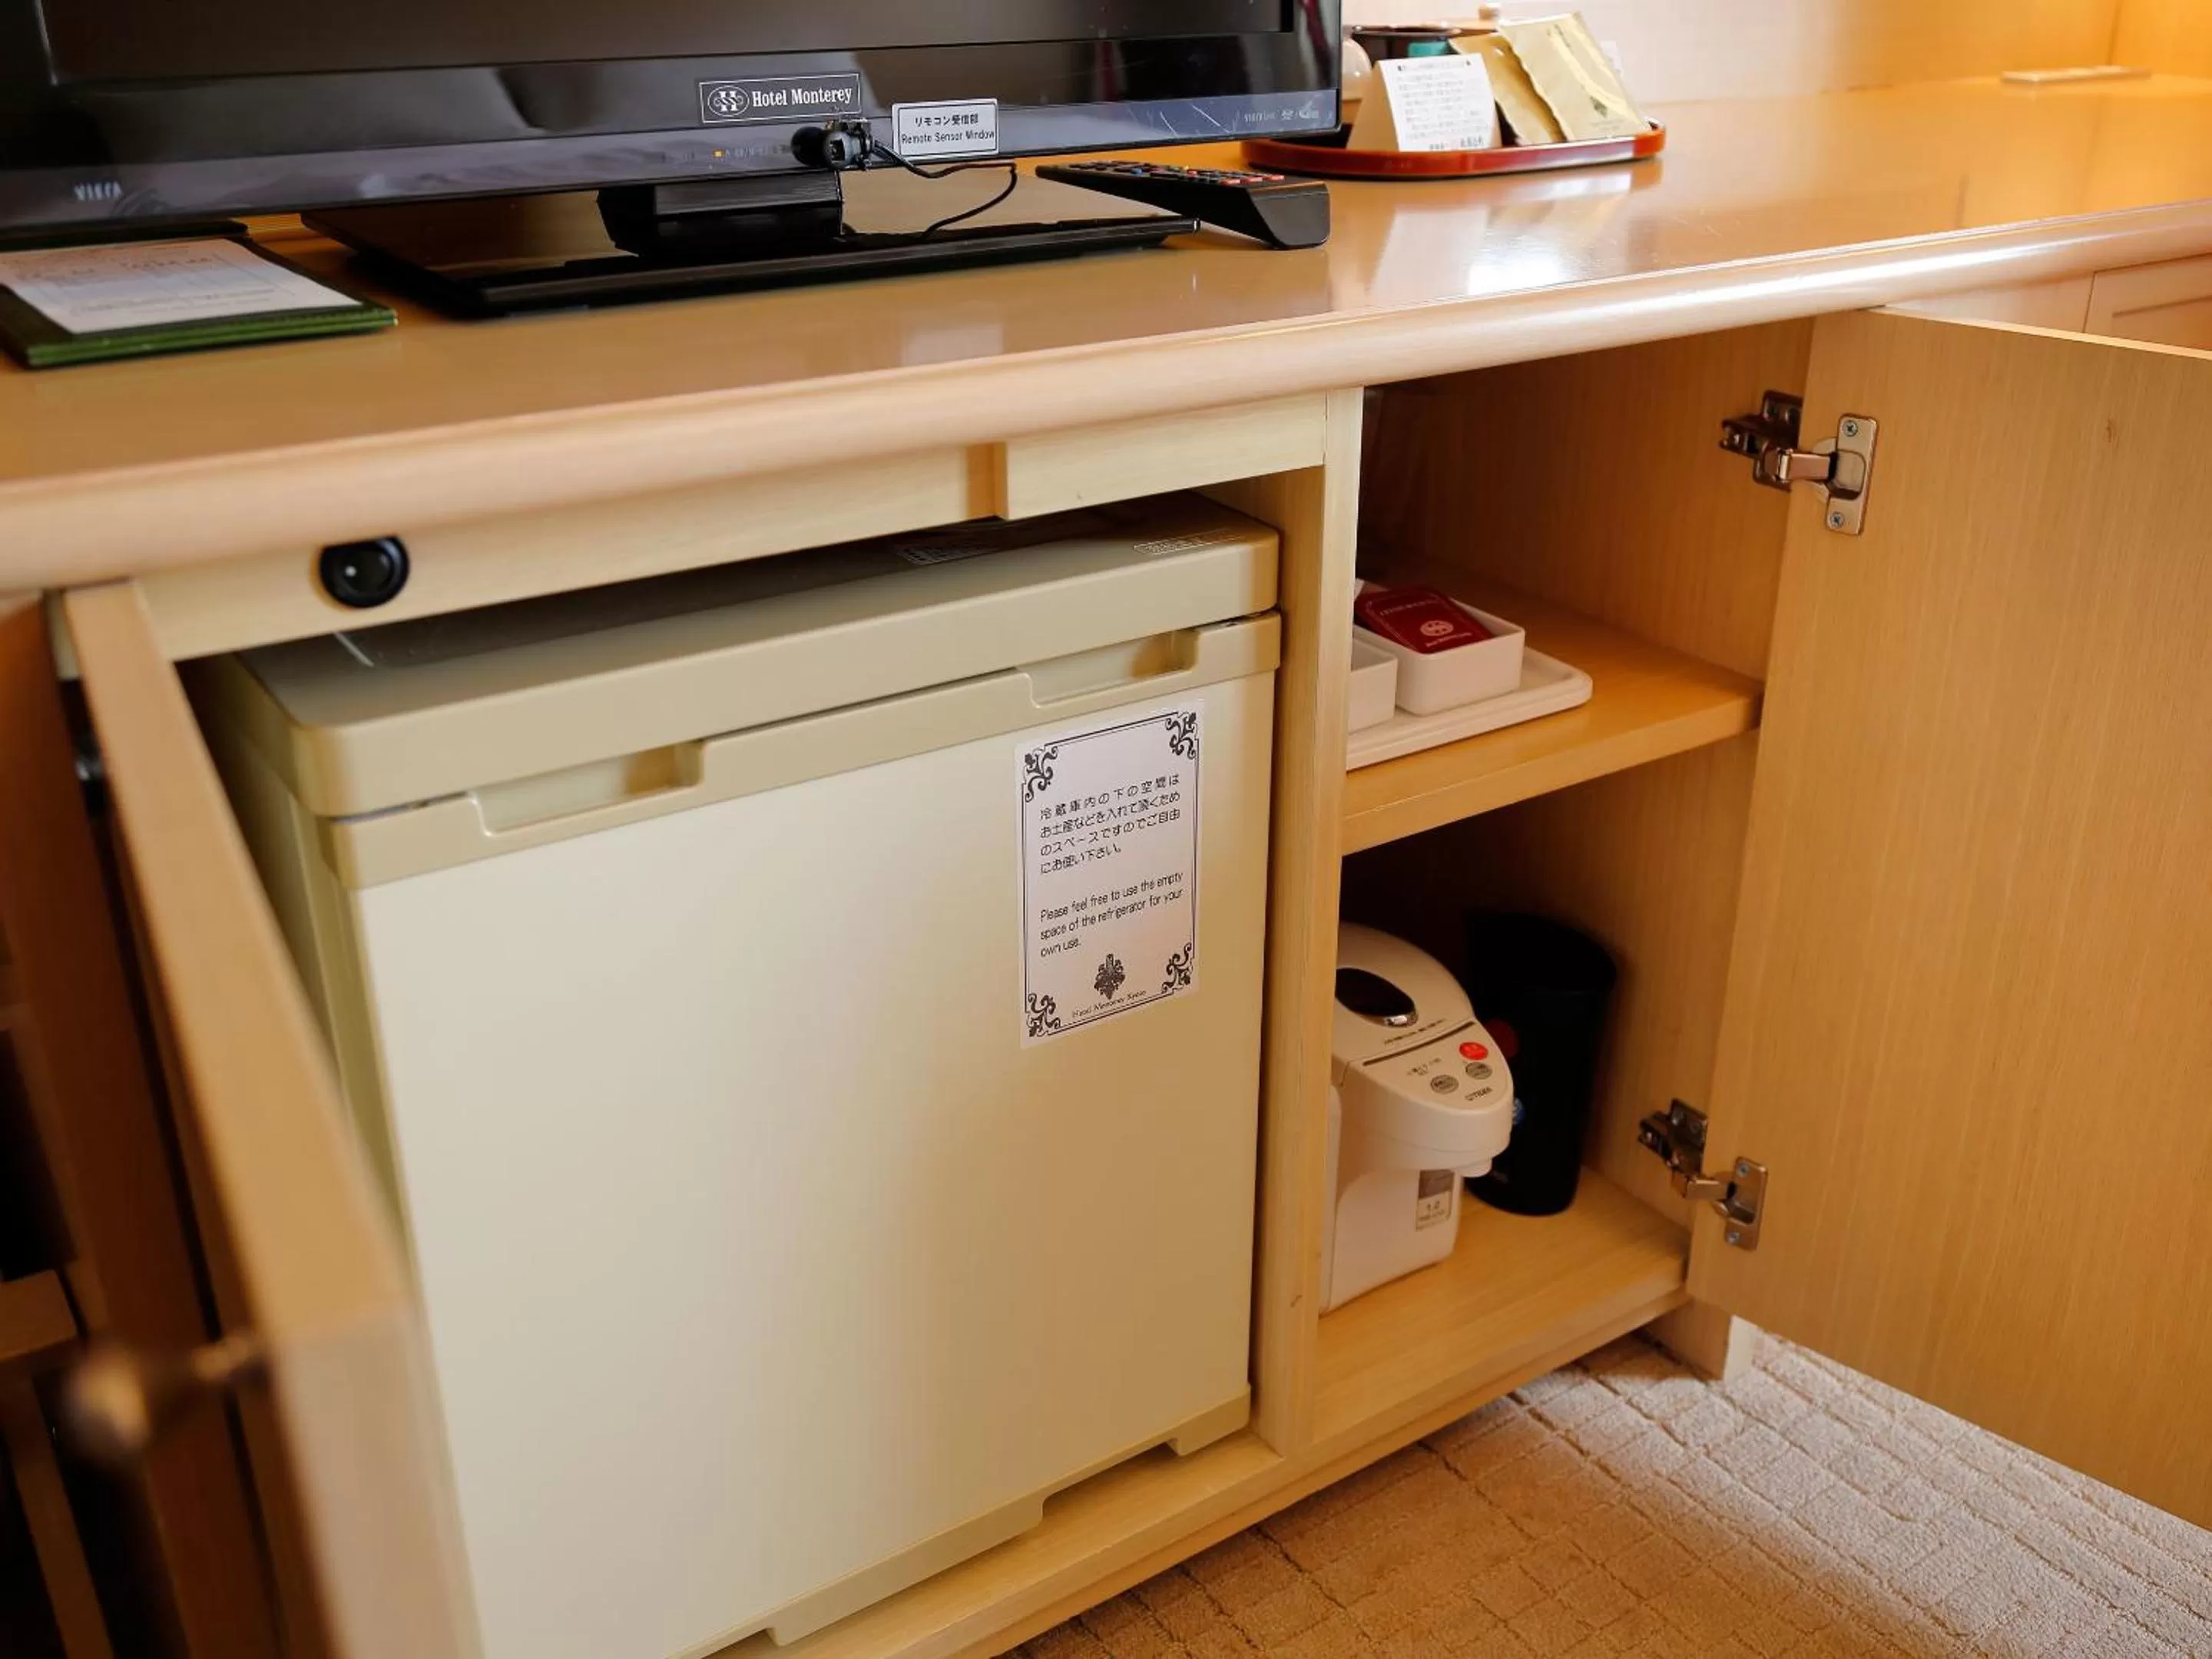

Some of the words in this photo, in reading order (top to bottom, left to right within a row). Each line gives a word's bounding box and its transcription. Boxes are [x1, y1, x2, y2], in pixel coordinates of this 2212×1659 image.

[752, 90, 788, 107] Hotel
[791, 88, 853, 105] Monterey
[915, 113, 979, 127] リモコン受信部
[901, 134, 932, 144] Remote
[935, 131, 963, 142] Sensor
[965, 129, 995, 140] Window
[1041, 808, 1181, 856] のスペースですのでご自由
[1041, 843, 1121, 874] にお使い下さい。
[1041, 906, 1068, 922] Please
[1071, 897, 1088, 912] feel
[1091, 894, 1108, 906] free
[1111, 890, 1121, 901] to
[1123, 886, 1138, 897] use
[1141, 879, 1154, 892] the
[1157, 872, 1184, 887] empty
[1040, 924, 1067, 940] space
[1068, 917, 1079, 931] of
[1082, 915, 1096, 926] the
[1098, 900, 1146, 922] refrigerator
[1149, 894, 1161, 907] for
[1164, 889, 1184, 904] your
[1041, 942, 1061, 958] own
[1063, 938, 1081, 951] use.
